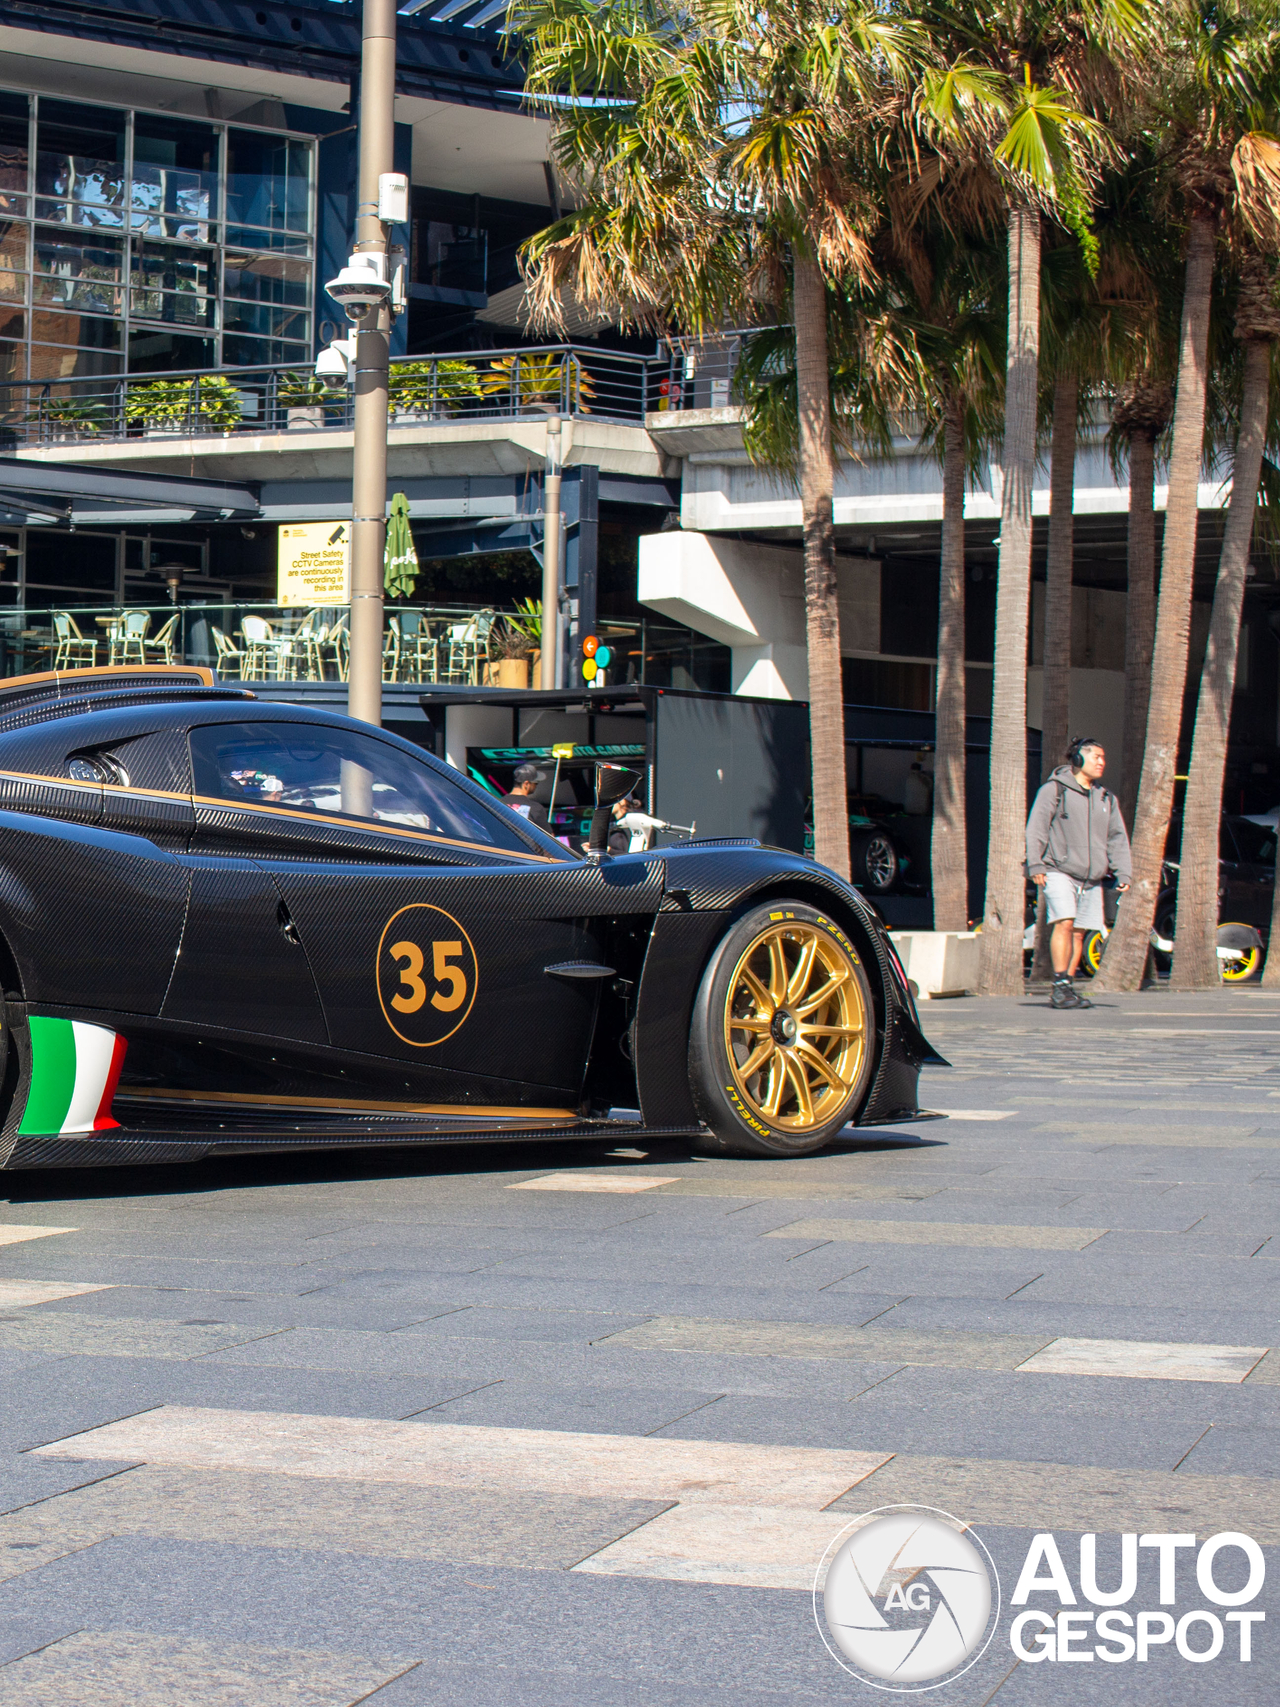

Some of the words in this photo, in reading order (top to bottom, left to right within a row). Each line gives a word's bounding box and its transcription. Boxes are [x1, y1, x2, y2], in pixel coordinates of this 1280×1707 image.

[301, 567, 344, 576] continuously
[304, 576, 336, 584] recording
[827, 924, 859, 964] ZERO
[390, 941, 467, 1014] 35
[726, 1086, 770, 1137] PIRELLI
